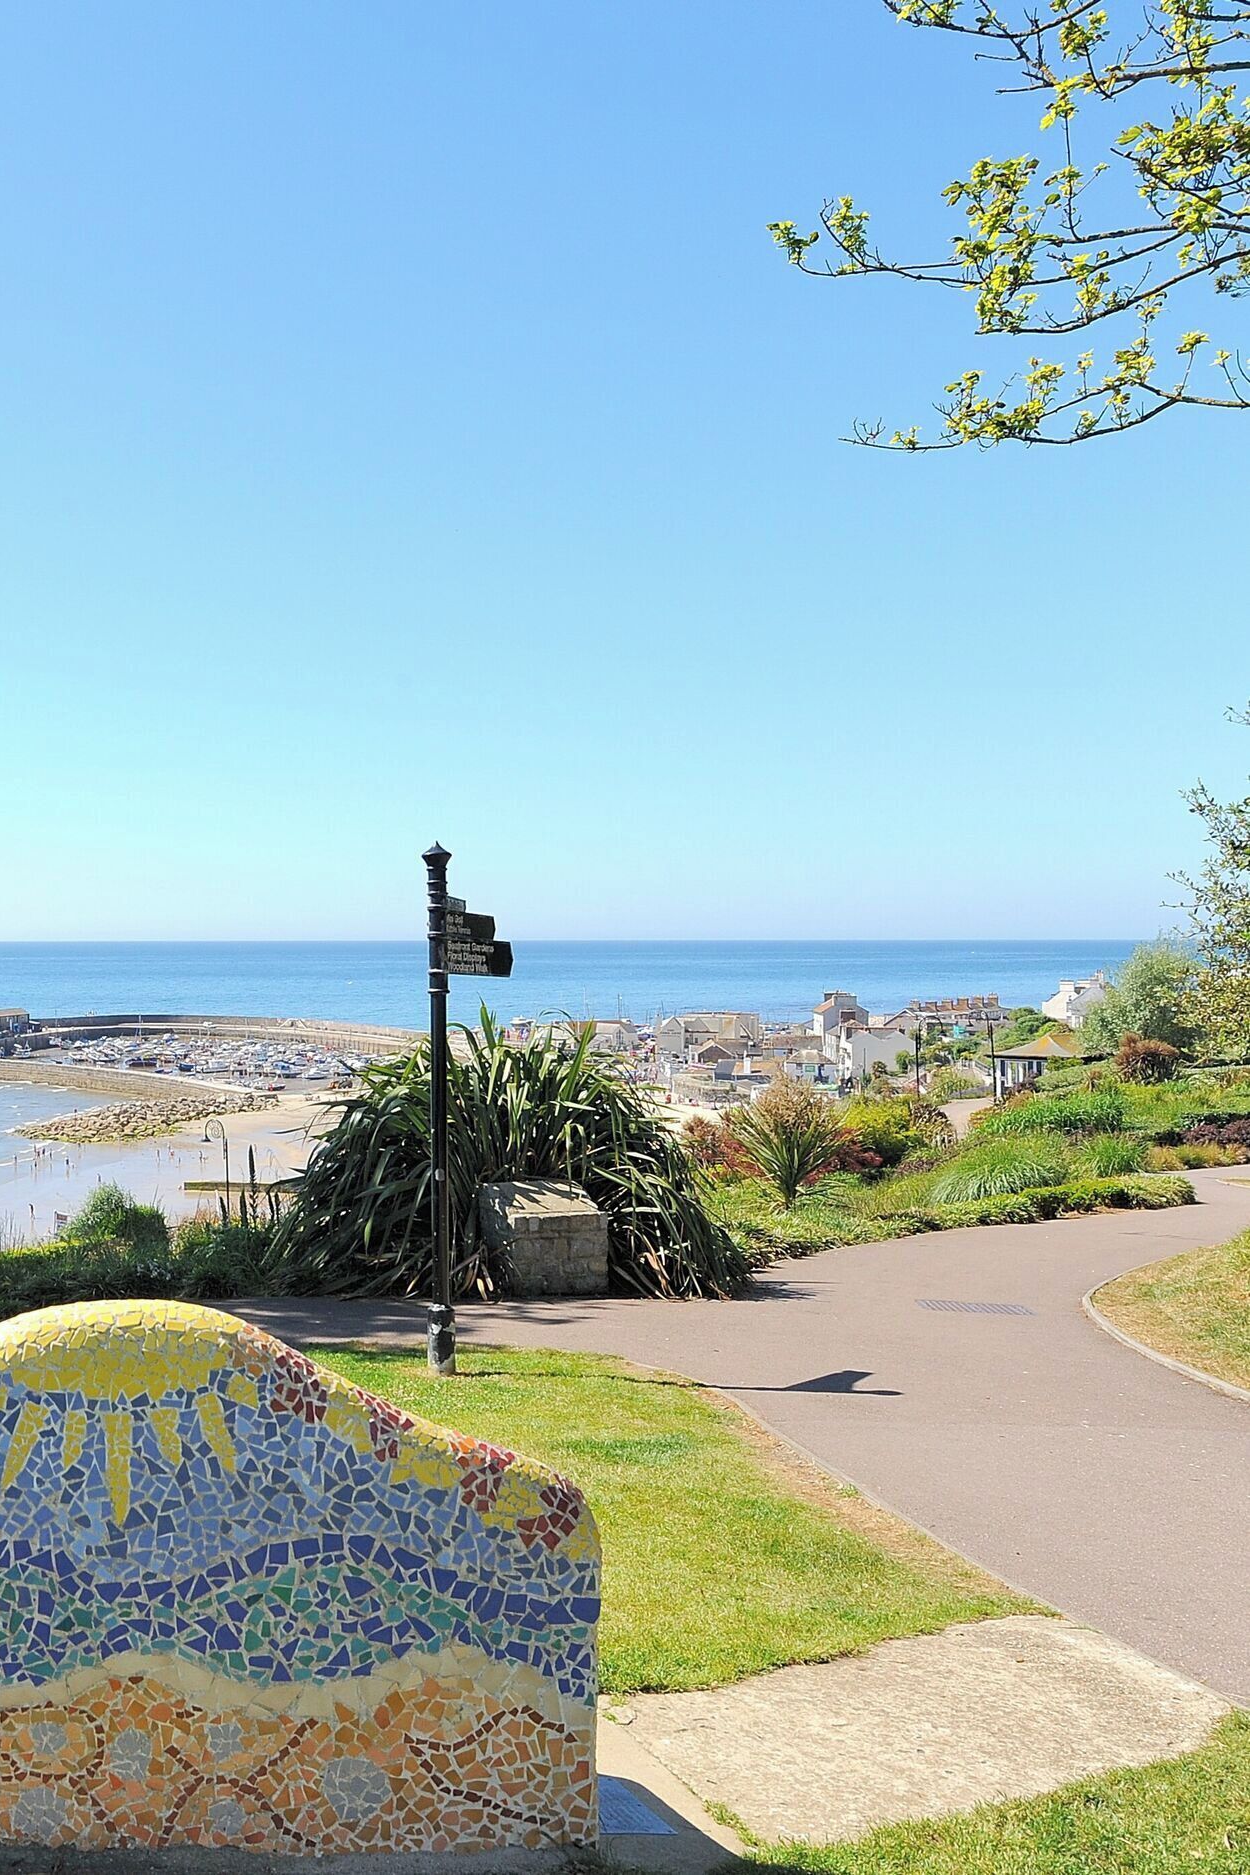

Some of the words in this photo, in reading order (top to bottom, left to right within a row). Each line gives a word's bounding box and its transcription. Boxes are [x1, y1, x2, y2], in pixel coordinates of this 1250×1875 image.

[447, 941, 471, 951] Seafront
[471, 943, 495, 953] Gardens
[447, 951, 462, 961] Floral
[463, 952, 486, 964] Displays
[447, 961, 474, 972] Woodland
[475, 963, 489, 973] Walk
